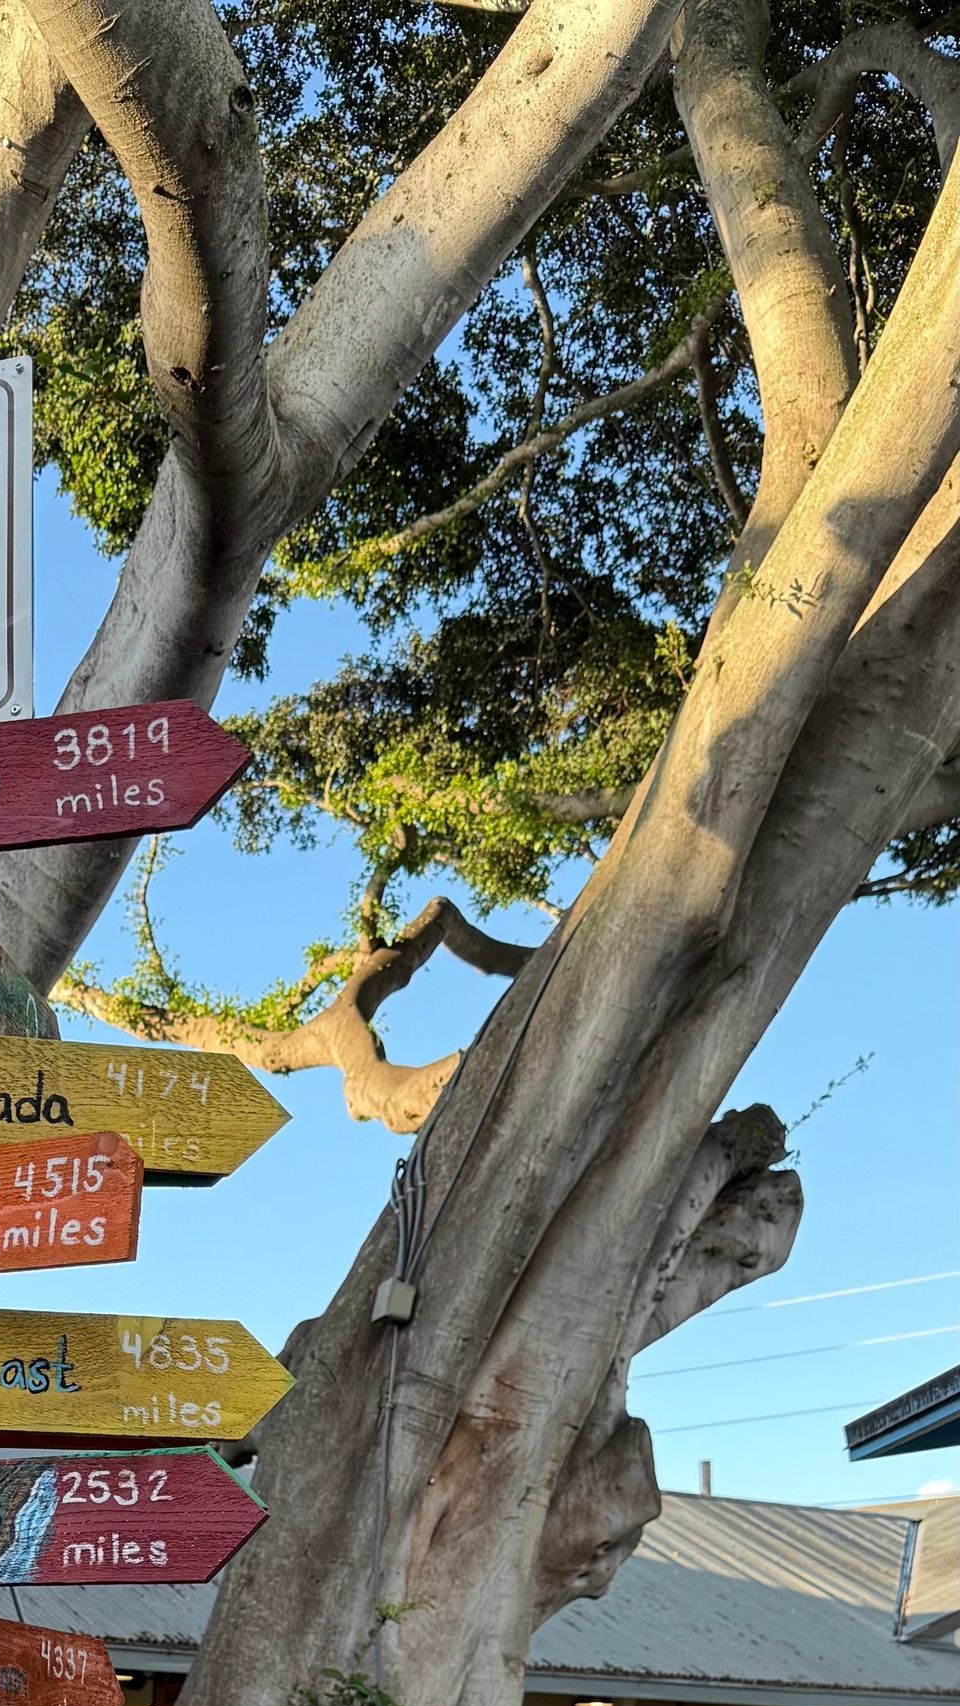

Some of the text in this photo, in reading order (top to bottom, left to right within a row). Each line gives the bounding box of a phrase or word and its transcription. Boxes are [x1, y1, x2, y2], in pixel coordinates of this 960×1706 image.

[53, 716, 170, 771] 3819
[56, 774, 165, 816] miles
[106, 1061, 211, 1105] 4174
[14, 1155, 112, 1201] 4515
[2, 1207, 108, 1250] miles
[122, 1329, 231, 1374] 4835
[122, 1393, 222, 1428] miles
[62, 1469, 174, 1506] 2532
[62, 1533, 168, 1568] miles
[40, 1639, 89, 1684] 4337
